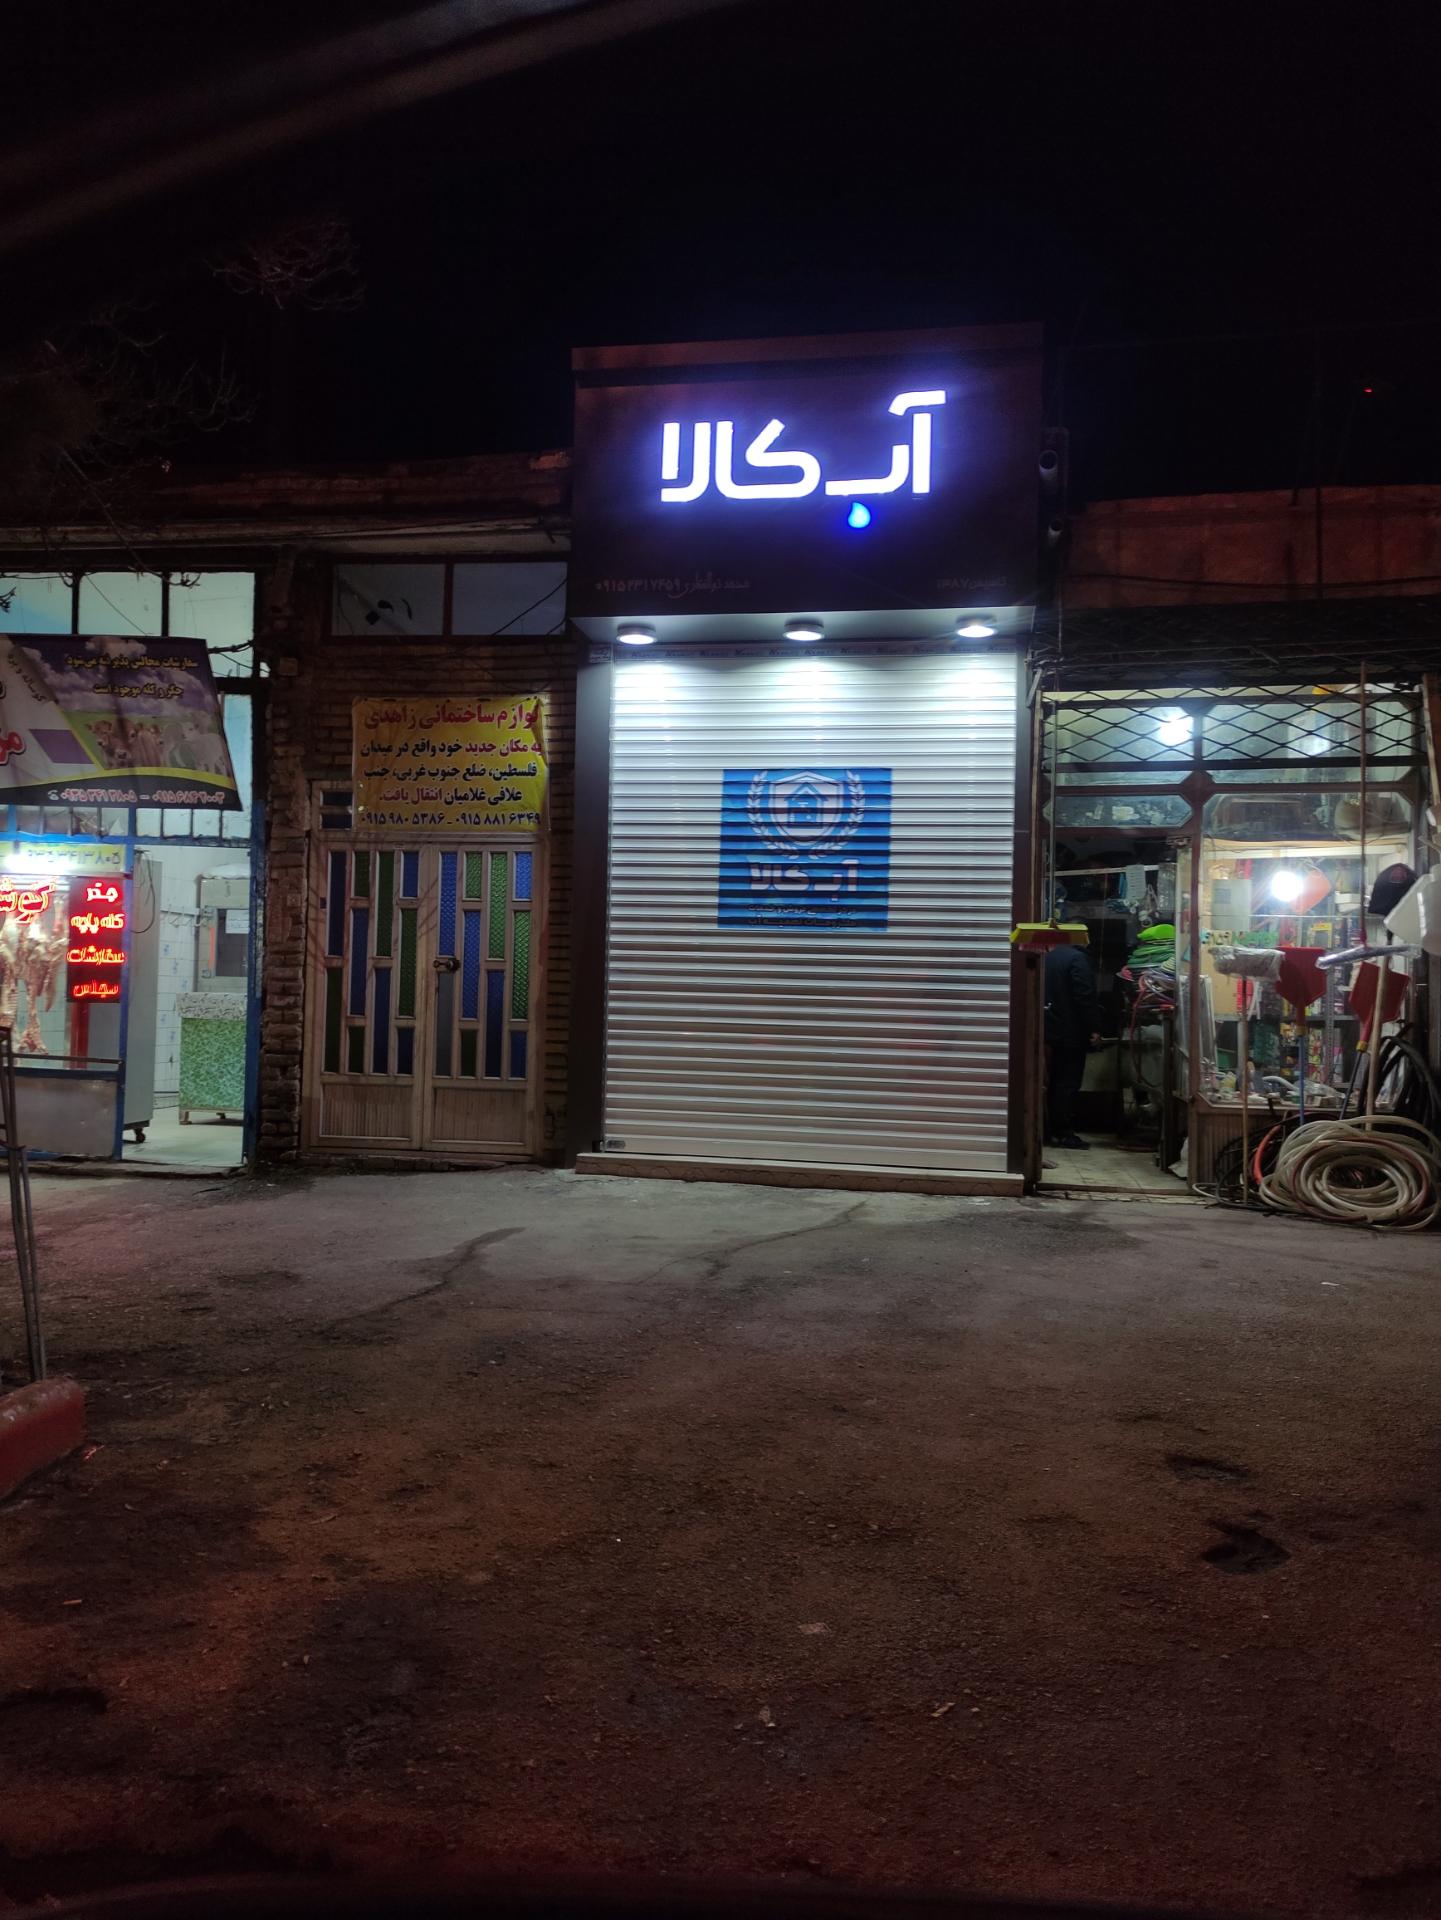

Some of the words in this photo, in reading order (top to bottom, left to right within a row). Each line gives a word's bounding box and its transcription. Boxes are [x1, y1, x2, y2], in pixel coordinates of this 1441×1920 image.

[365, 703, 416, 730] زاهدی
[418, 702, 495, 729] ساختمانی
[497, 702, 540, 729] لوازم
[360, 739, 394, 758] میدان
[395, 741, 410, 758] در
[411, 738, 436, 758] واقع
[439, 738, 463, 758] خود
[465, 741, 497, 758] جدید
[499, 739, 529, 757] مکان
[531, 742, 543, 757] به
[363, 765, 390, 781] جنب
[428, 765, 460, 781] جنوب
[462, 763, 486, 781] ضلع
[411, 787, 443, 806] انتقال
[444, 787, 487, 806] غلامیان
[488, 787, 523, 806] علافی
[70, 912, 99, 935] پاچه
[100, 913, 125, 929] کله
[65, 945, 126, 966] سفارشات
